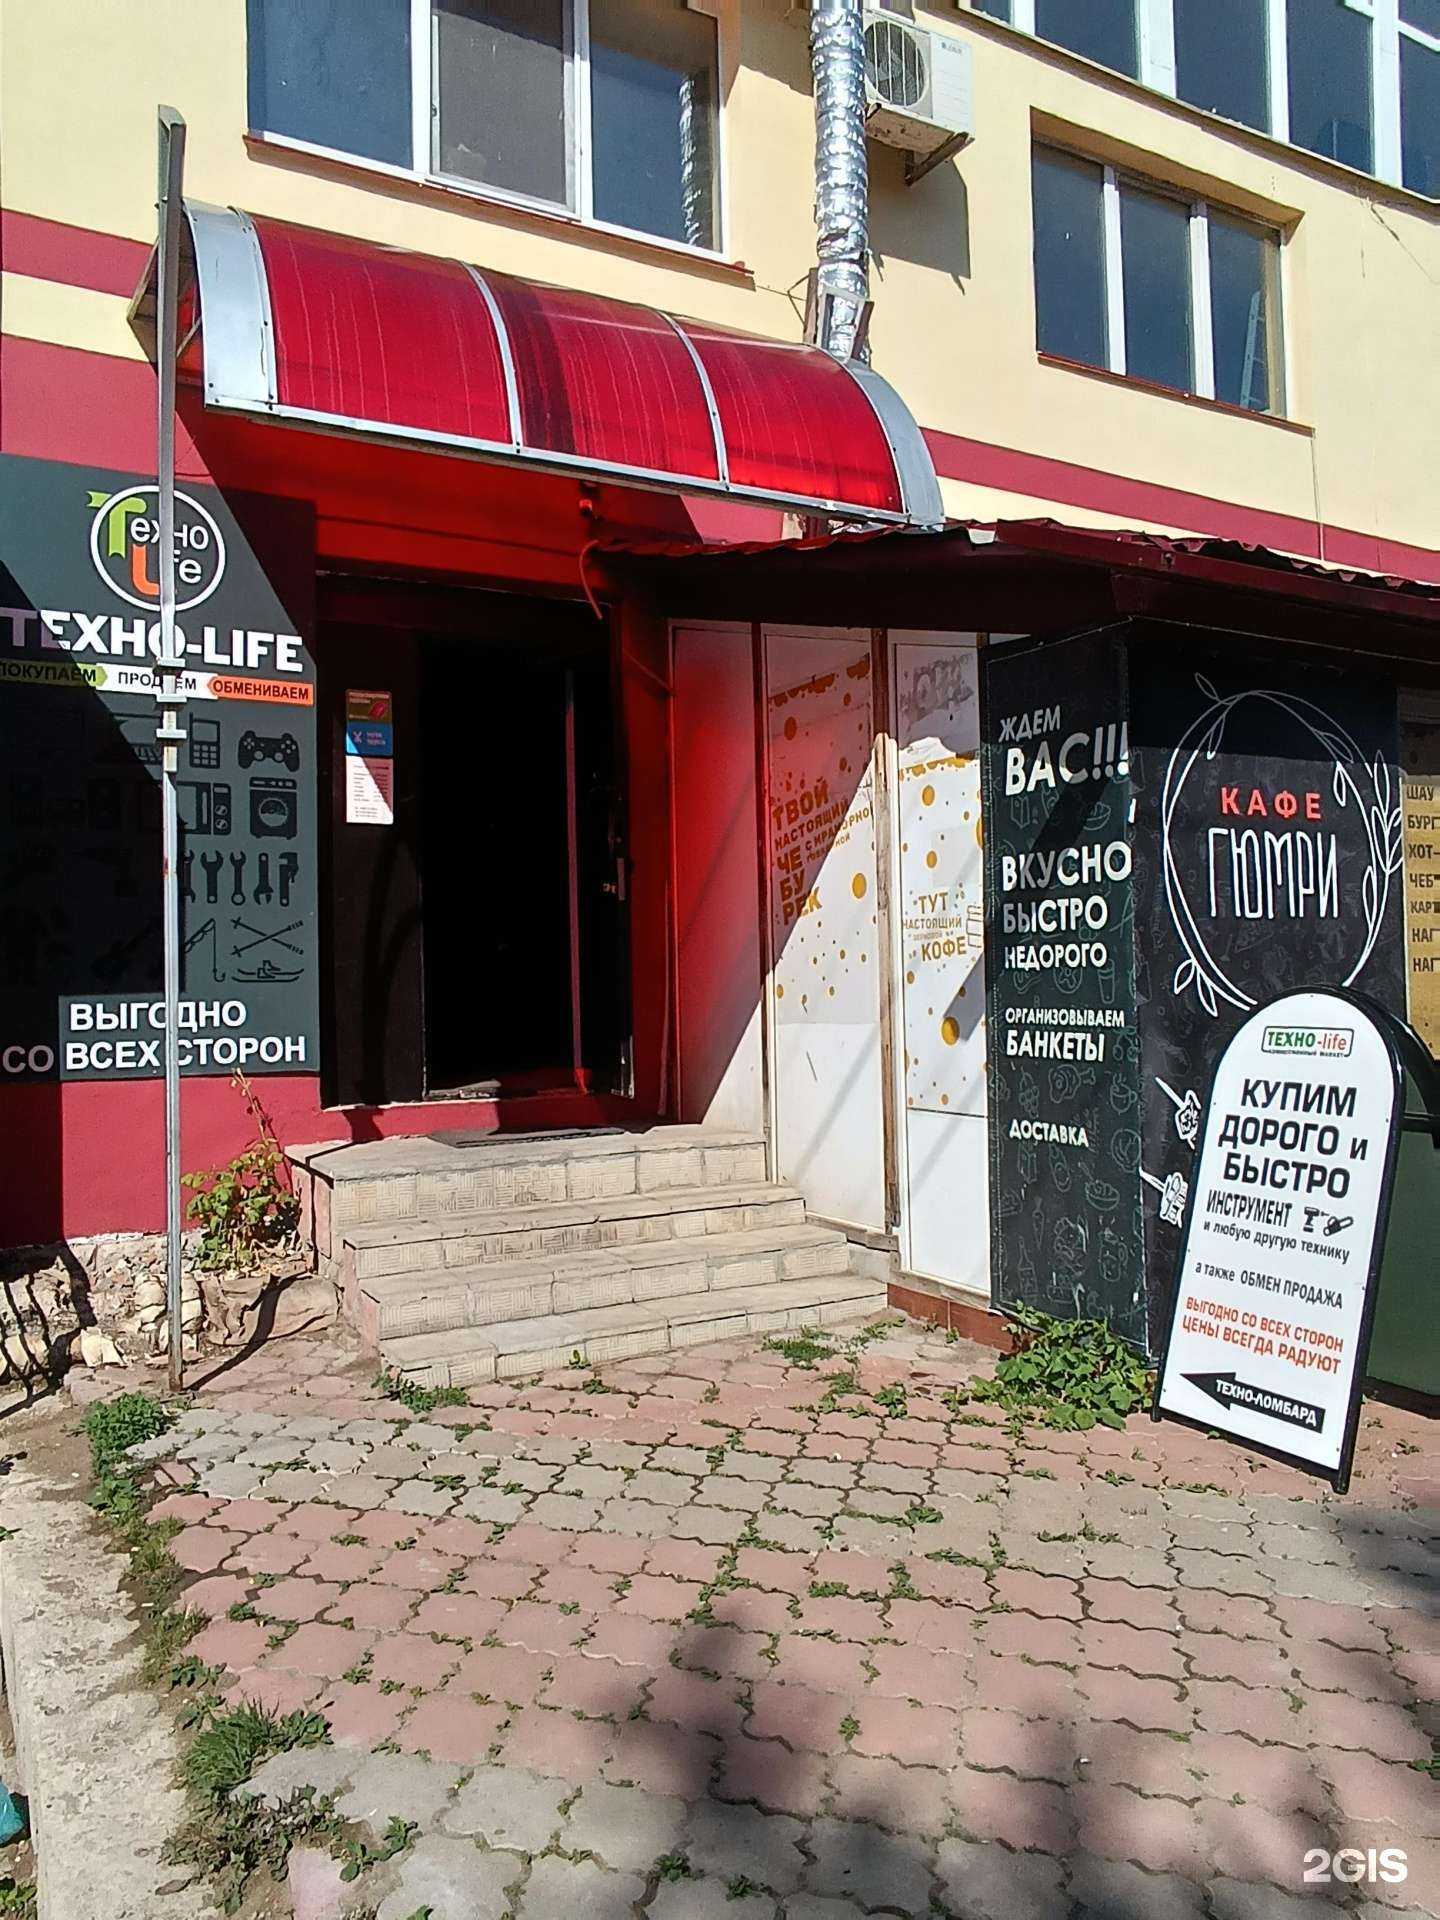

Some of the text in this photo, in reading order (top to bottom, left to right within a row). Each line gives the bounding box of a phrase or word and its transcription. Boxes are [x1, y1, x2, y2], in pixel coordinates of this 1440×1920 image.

[118, 671, 197, 694] ПРОДЕМ
[213, 680, 309, 700] ОБМЕНИВАЕМ
[998, 704, 1060, 742] ЖДЕМ
[1005, 721, 1129, 796] ВАС!!!
[772, 776, 828, 831] ТВОЙ
[1221, 787, 1321, 820] КАФЕ
[776, 844, 803, 875] ЧЕ
[1002, 841, 1132, 892] ВКУСНО
[1208, 827, 1339, 920] ГЮМРИ
[779, 868, 805, 902] БУ
[1409, 873, 1440, 889] ЧЕБ
[919, 892, 948, 914] ТУТ
[1003, 895, 1108, 934] БЫСТРО
[921, 936, 967, 962] КОФЕ
[1004, 942, 1107, 971] НЕДОРОГО
[70, 1001, 247, 1031] ВЫГОДНО
[1005, 1007, 1125, 1028] ОРГАНИЗОВЫВАЕМ
[2, 1036, 306, 1073] СО ВСЕХ СТОРОН
[1006, 1029, 1105, 1062] БАНКЕТЫ
[1241, 1079, 1357, 1117] КУПИМ
[1009, 1119, 1090, 1148] ДОСТАВКА
[1218, 1114, 1340, 1155] ДОРОГО
[1223, 1152, 1350, 1199] БЫСТРО
[1206, 1189, 1293, 1228] ИНСТРУМЕНТ
[1203, 1220, 1350, 1265] и любую другую технику
[1195, 1262, 1344, 1309] а также ОБМЕН ПРОДАЖА
[1186, 1296, 1344, 1353] ВЫГОДНО СО ВСЕХ СТОРОН
[1182, 1315, 1341, 1375] ЦЕНЫ ВСЕГДА РАДУЮТ
[1215, 1379, 1317, 1427] ТЕХНО-ЛОМБАРД
